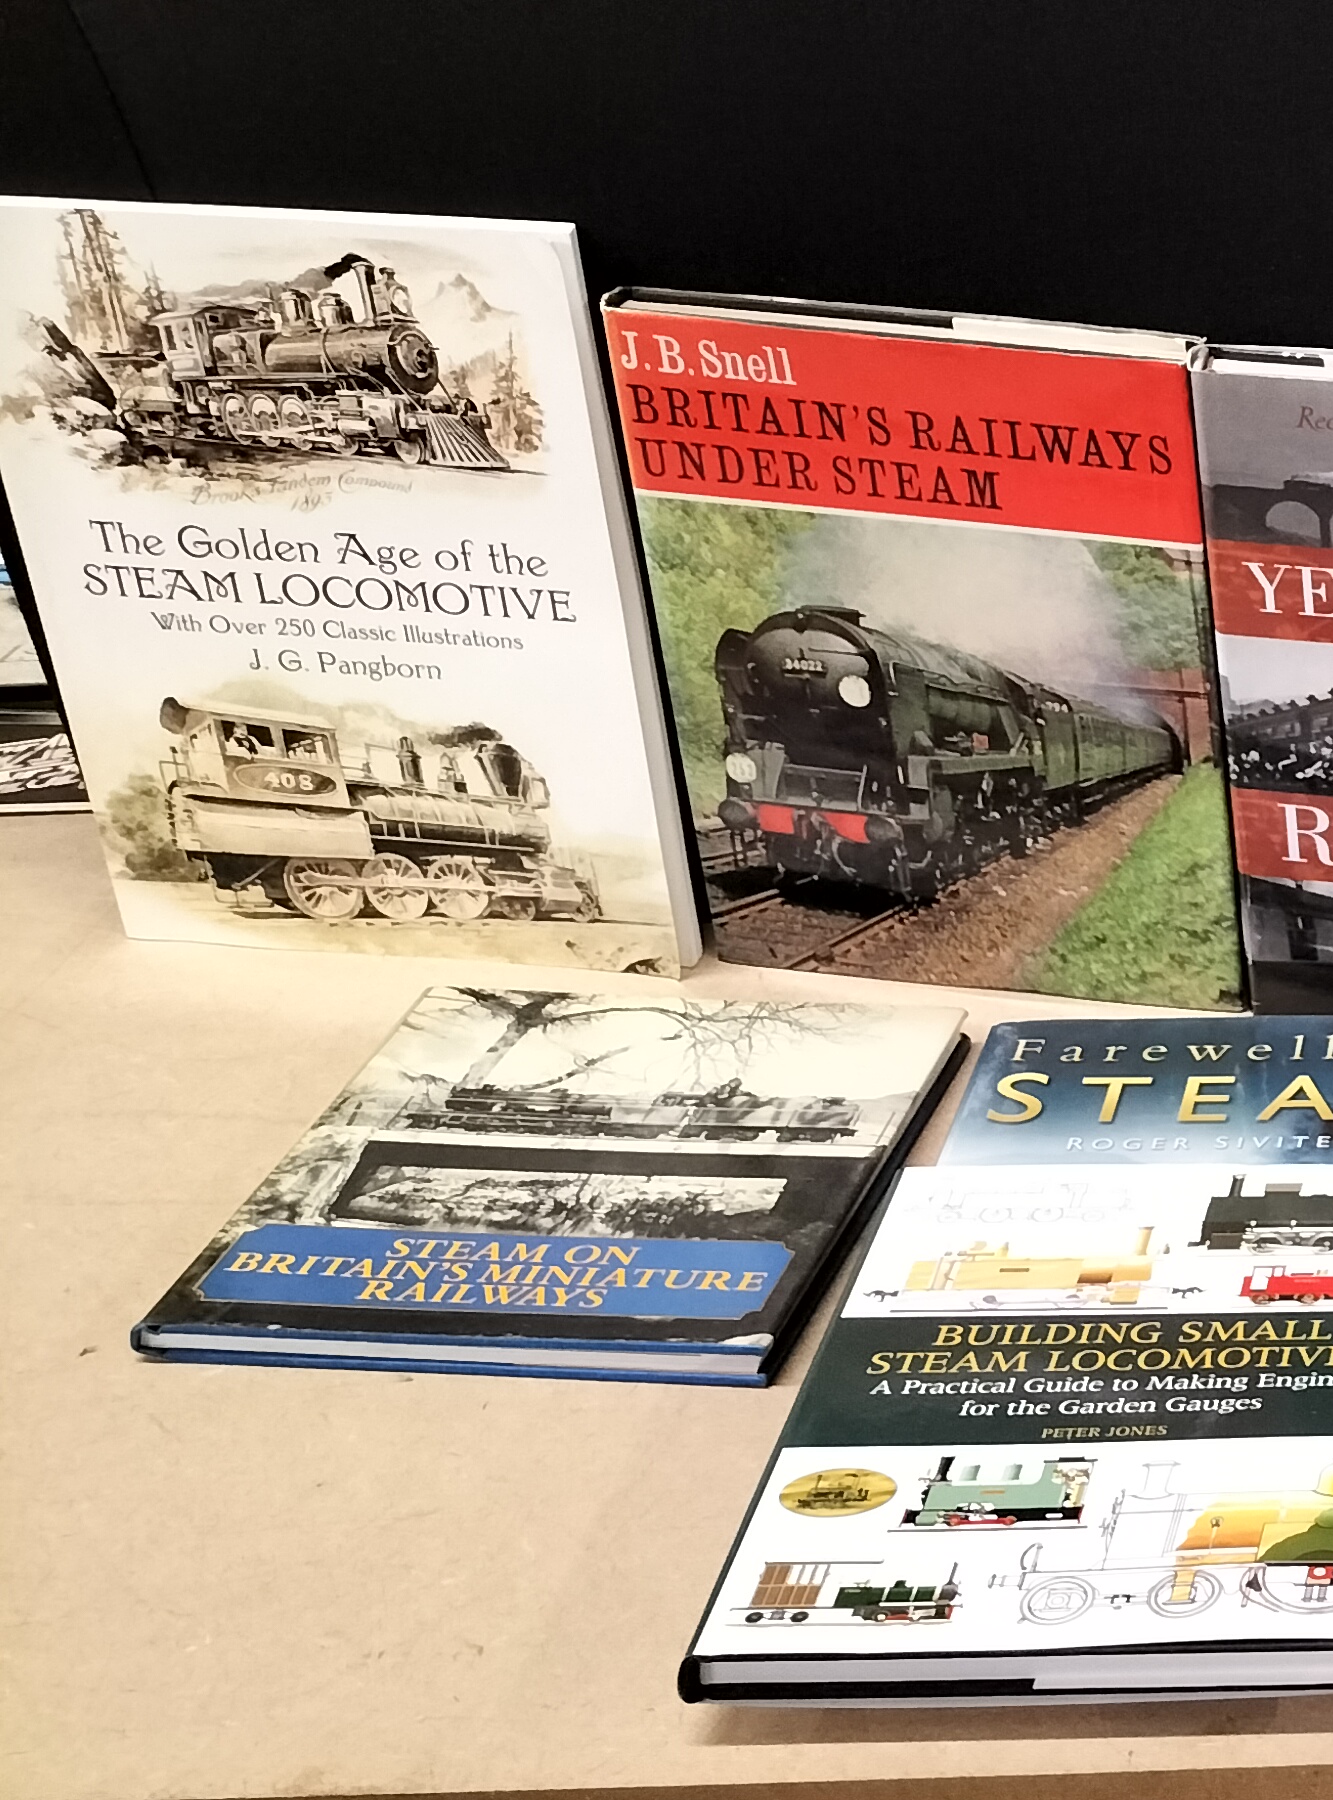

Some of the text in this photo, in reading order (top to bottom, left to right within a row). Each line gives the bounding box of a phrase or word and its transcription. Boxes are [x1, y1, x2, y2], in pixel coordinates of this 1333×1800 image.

[626, 384, 1173, 476] BRITAIN'S RAILWAYS
[639, 438, 1003, 510] UNDER STEAM
[89, 520, 549, 578] The Golden Age of the
[83, 563, 577, 624] STEAM LOCOMOTIVE
[151, 611, 525, 651] With Over 250 Classic Illustrations
[249, 649, 443, 682] J. G. Pangborn
[1066, 1135, 1191, 1152] ROGER
[384, 1237, 643, 1266] STEAM ON
[224, 1251, 771, 1294] BRITAIN'S MINIATURE
[357, 1278, 608, 1309] RAILWAYS
[931, 1319, 1333, 1348] BUILDING SMALL
[865, 1349, 1029, 1376] STEAM
[869, 1379, 894, 1397] A
[901, 1375, 1017, 1397] Practical
[1023, 1373, 1106, 1395] Guide
[1111, 1374, 1140, 1393] to
[1144, 1372, 1250, 1397] Making
[956, 1395, 1264, 1419] for the Garden Gauges
[1041, 1423, 1169, 1441] PETER JONES
